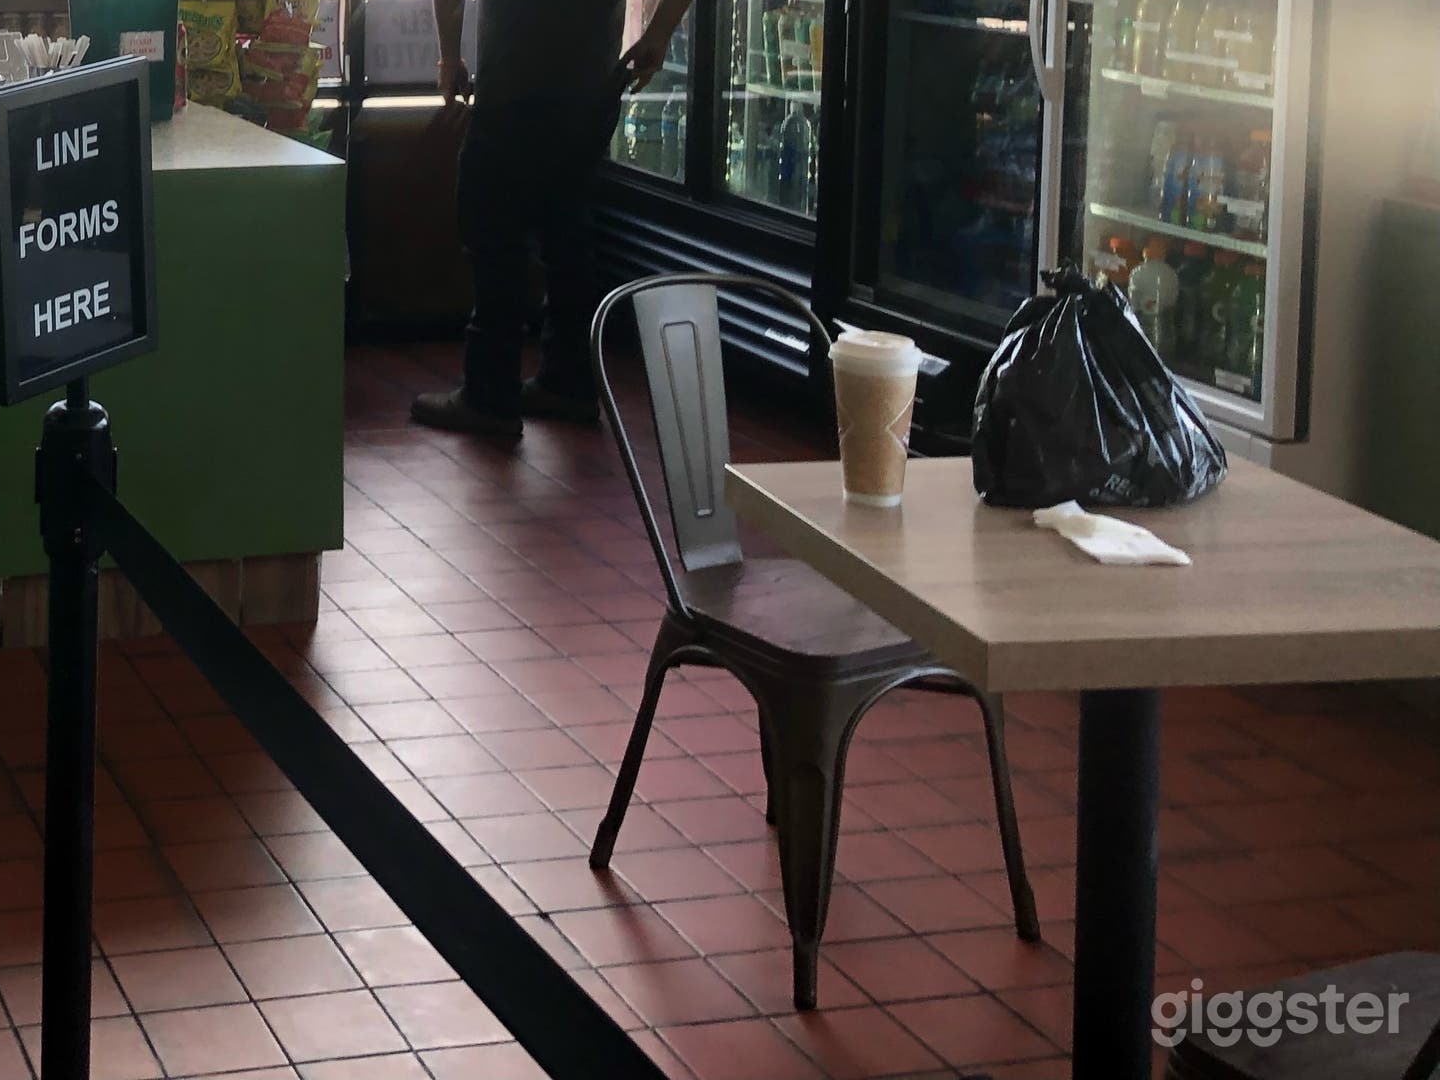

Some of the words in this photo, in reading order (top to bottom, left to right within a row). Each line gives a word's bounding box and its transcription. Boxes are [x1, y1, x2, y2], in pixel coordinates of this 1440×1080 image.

[36, 122, 100, 171] LINE
[19, 199, 119, 259] FORMS
[33, 280, 111, 337] HERE
